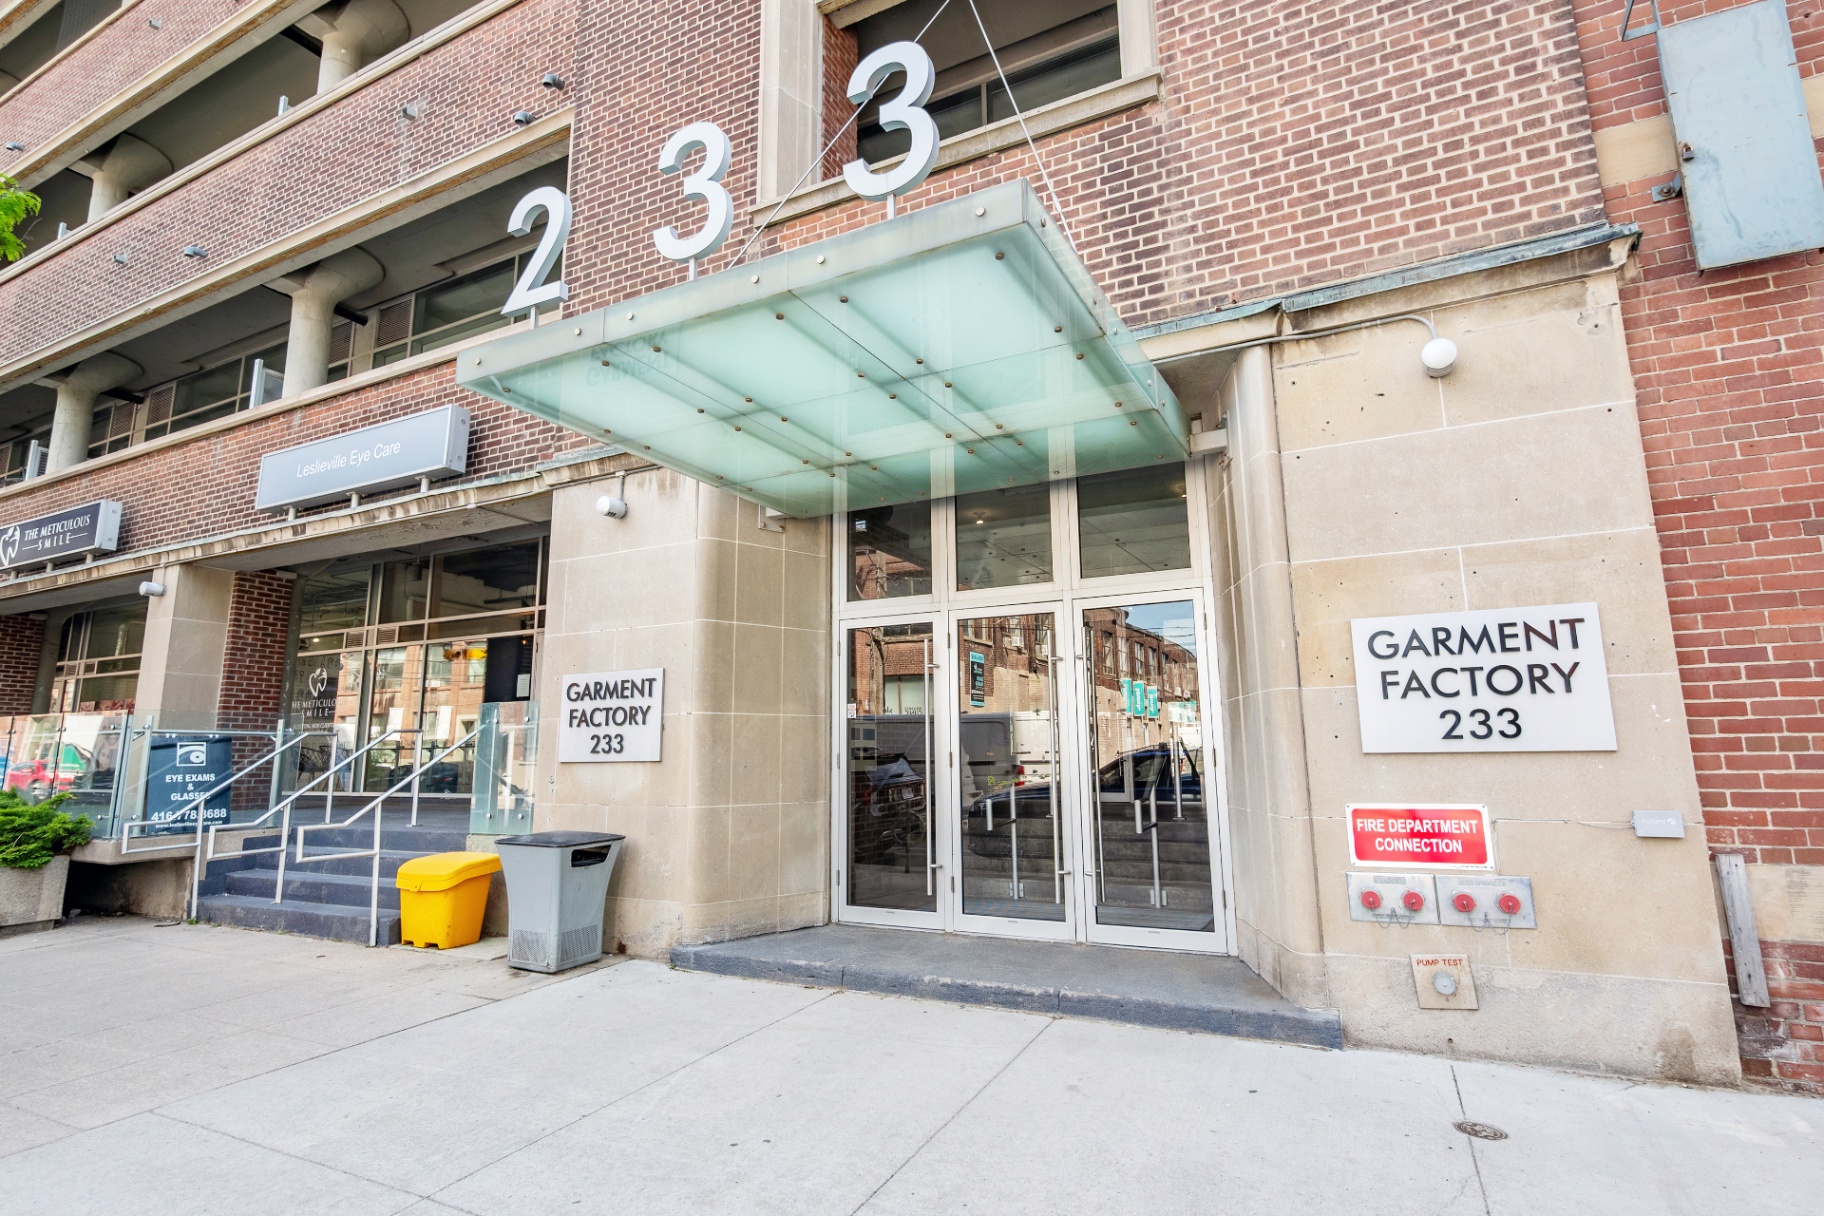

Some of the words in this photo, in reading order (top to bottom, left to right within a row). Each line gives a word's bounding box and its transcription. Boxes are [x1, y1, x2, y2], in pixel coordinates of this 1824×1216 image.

[502, 41, 940, 317] 233
[296, 454, 347, 478] Leslieville
[350, 449, 371, 467] Eye
[373, 442, 401, 459] Care
[24, 527, 39, 541] THE
[40, 514, 91, 540] METICULOUS
[37, 532, 71, 551] SMILE
[1367, 617, 1585, 660] GARMENT
[566, 678, 657, 702] GARMENT
[1380, 661, 1580, 700] FACTORY
[301, 707, 329, 717] SMILE
[302, 698, 346, 709] METICULO
[569, 705, 651, 728] FACTORY
[1439, 707, 1522, 740] 233
[590, 733, 624, 754] 233
[165, 774, 184, 783] EYE
[185, 773, 216, 782] EXAMS
[187, 783, 194, 791] &
[170, 791, 211, 801] GLASSE
[1356, 818, 1386, 832] FIRE
[1388, 819, 1478, 834] DEPARTMENT
[1375, 837, 1463, 853] CONNECTION
[1416, 958, 1439, 967] PUMP
[1442, 958, 1463, 966] TEST
